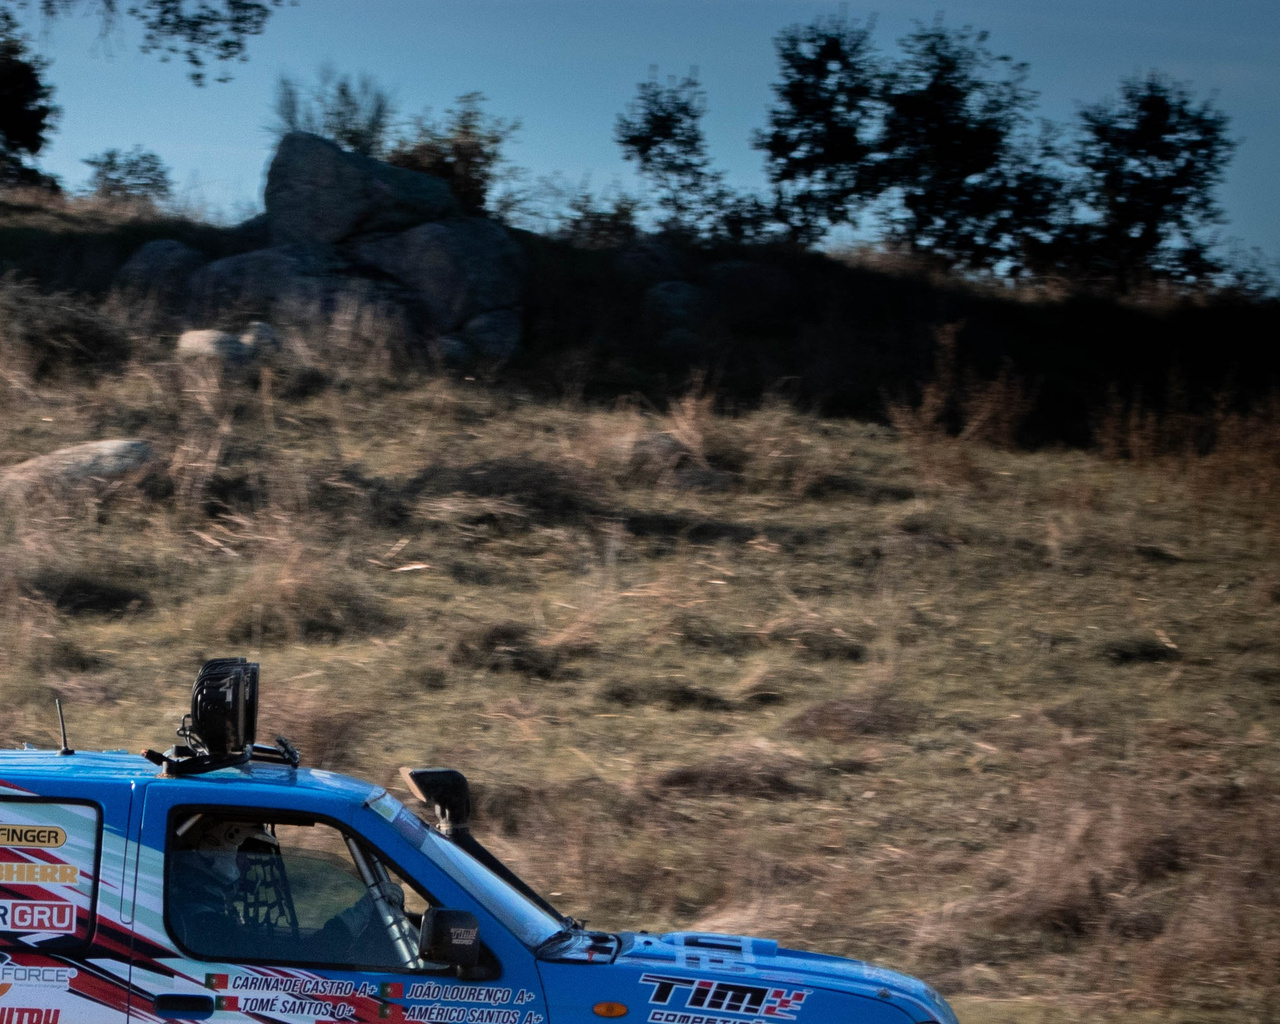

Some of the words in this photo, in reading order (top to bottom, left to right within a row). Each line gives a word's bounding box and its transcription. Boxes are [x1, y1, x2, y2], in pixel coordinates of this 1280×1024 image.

[232, 975, 278, 991] CARINA
[282, 979, 299, 993] DE
[302, 979, 354, 995] CASTRO
[357, 982, 377, 997] A+
[406, 981, 441, 999] JOÃO
[442, 984, 511, 1005] LOURENÇO
[514, 988, 535, 1004] A+
[241, 995, 279, 1012] TOMÉ
[280, 999, 331, 1016] SANTOS
[404, 1003, 467, 1023] AMÉRICO
[468, 1007, 520, 1024] SANTOS
